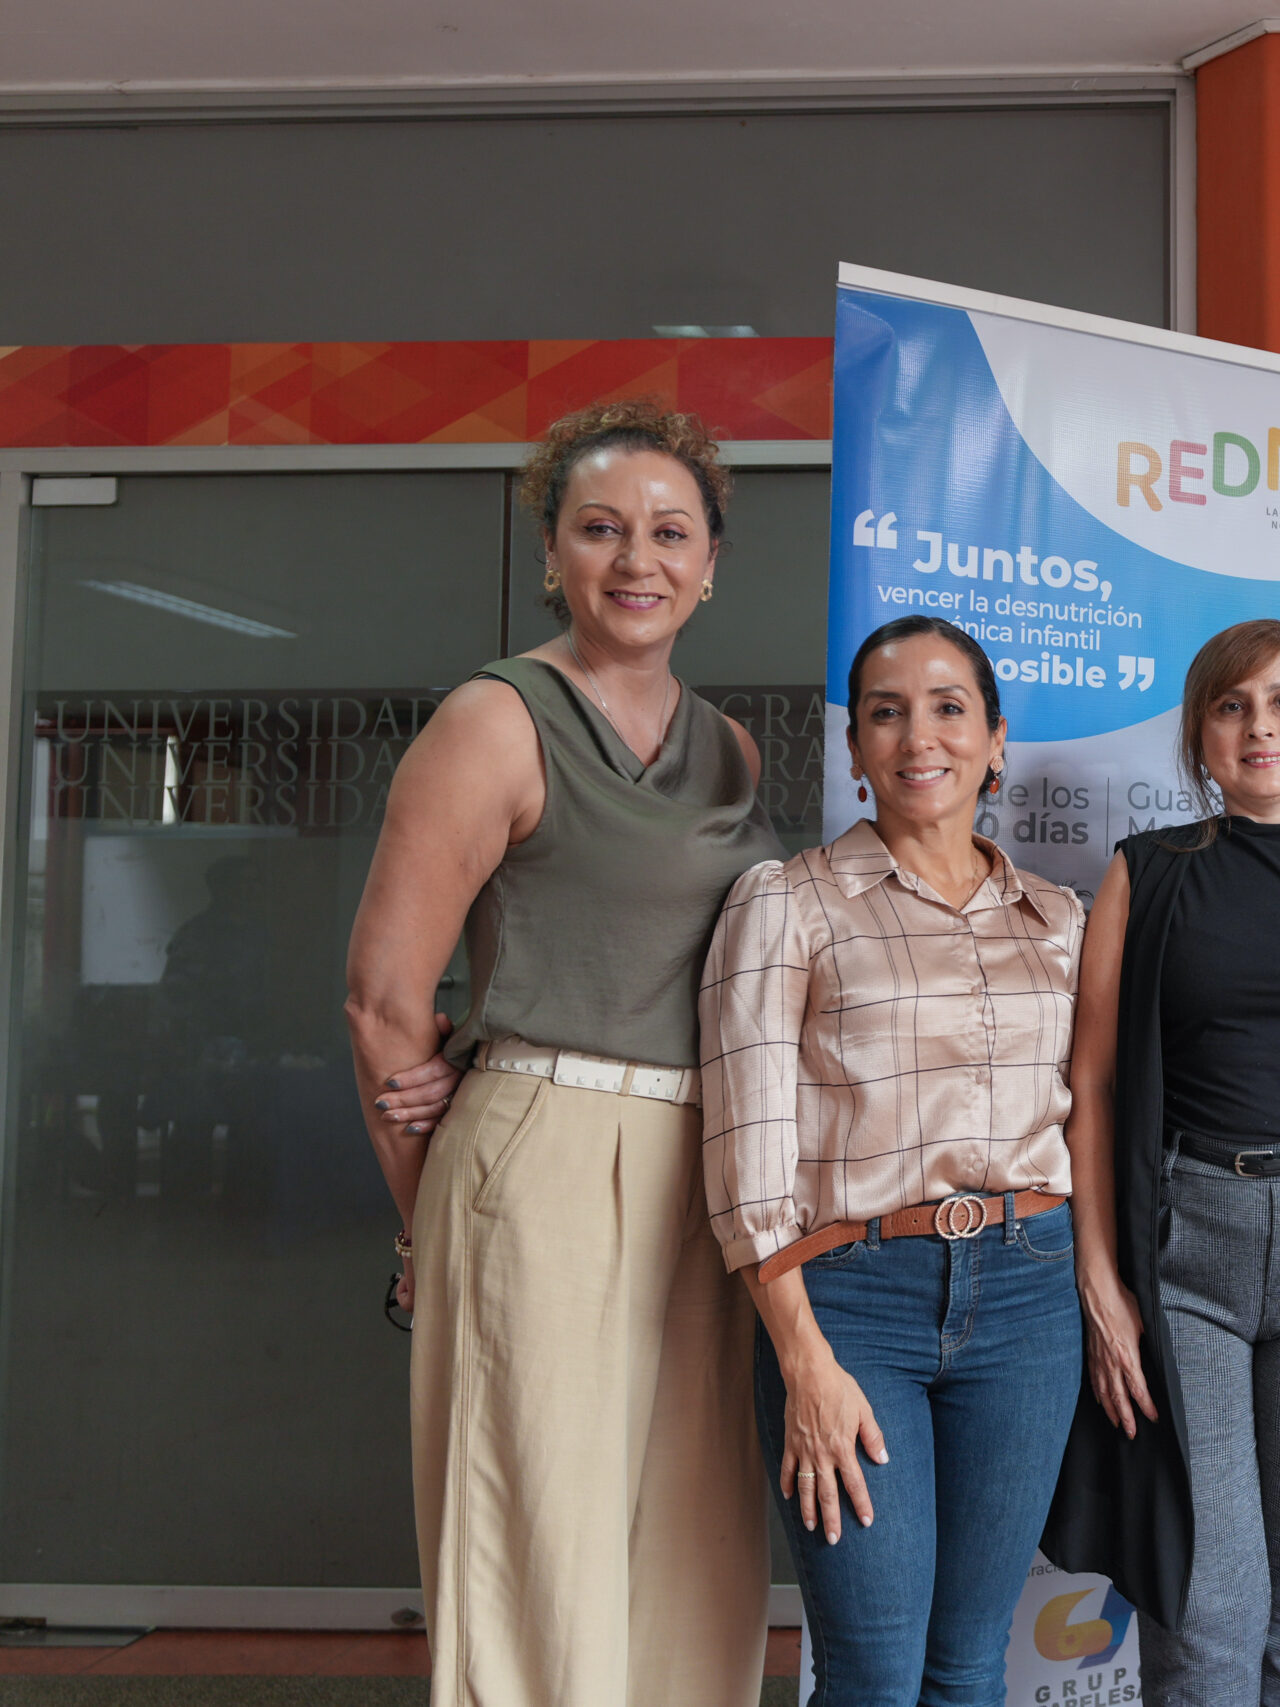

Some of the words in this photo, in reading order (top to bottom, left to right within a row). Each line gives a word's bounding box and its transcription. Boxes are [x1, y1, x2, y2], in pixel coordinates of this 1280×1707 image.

[1266, 507, 1278, 517] LA
[912, 530, 1113, 602] Juntos,
[877, 585, 967, 609] vencer
[969, 588, 989, 613] la
[994, 592, 1143, 630] desnutrición
[1020, 622, 1101, 651] infantil
[988, 651, 1107, 690] osible
[53, 739, 397, 785] UNIVERSIDA
[52, 783, 388, 827] UNIVERSIDA
[1043, 777, 1090, 810] los
[1013, 812, 1090, 845] días
[1035, 1665, 1141, 1703] GRUP
